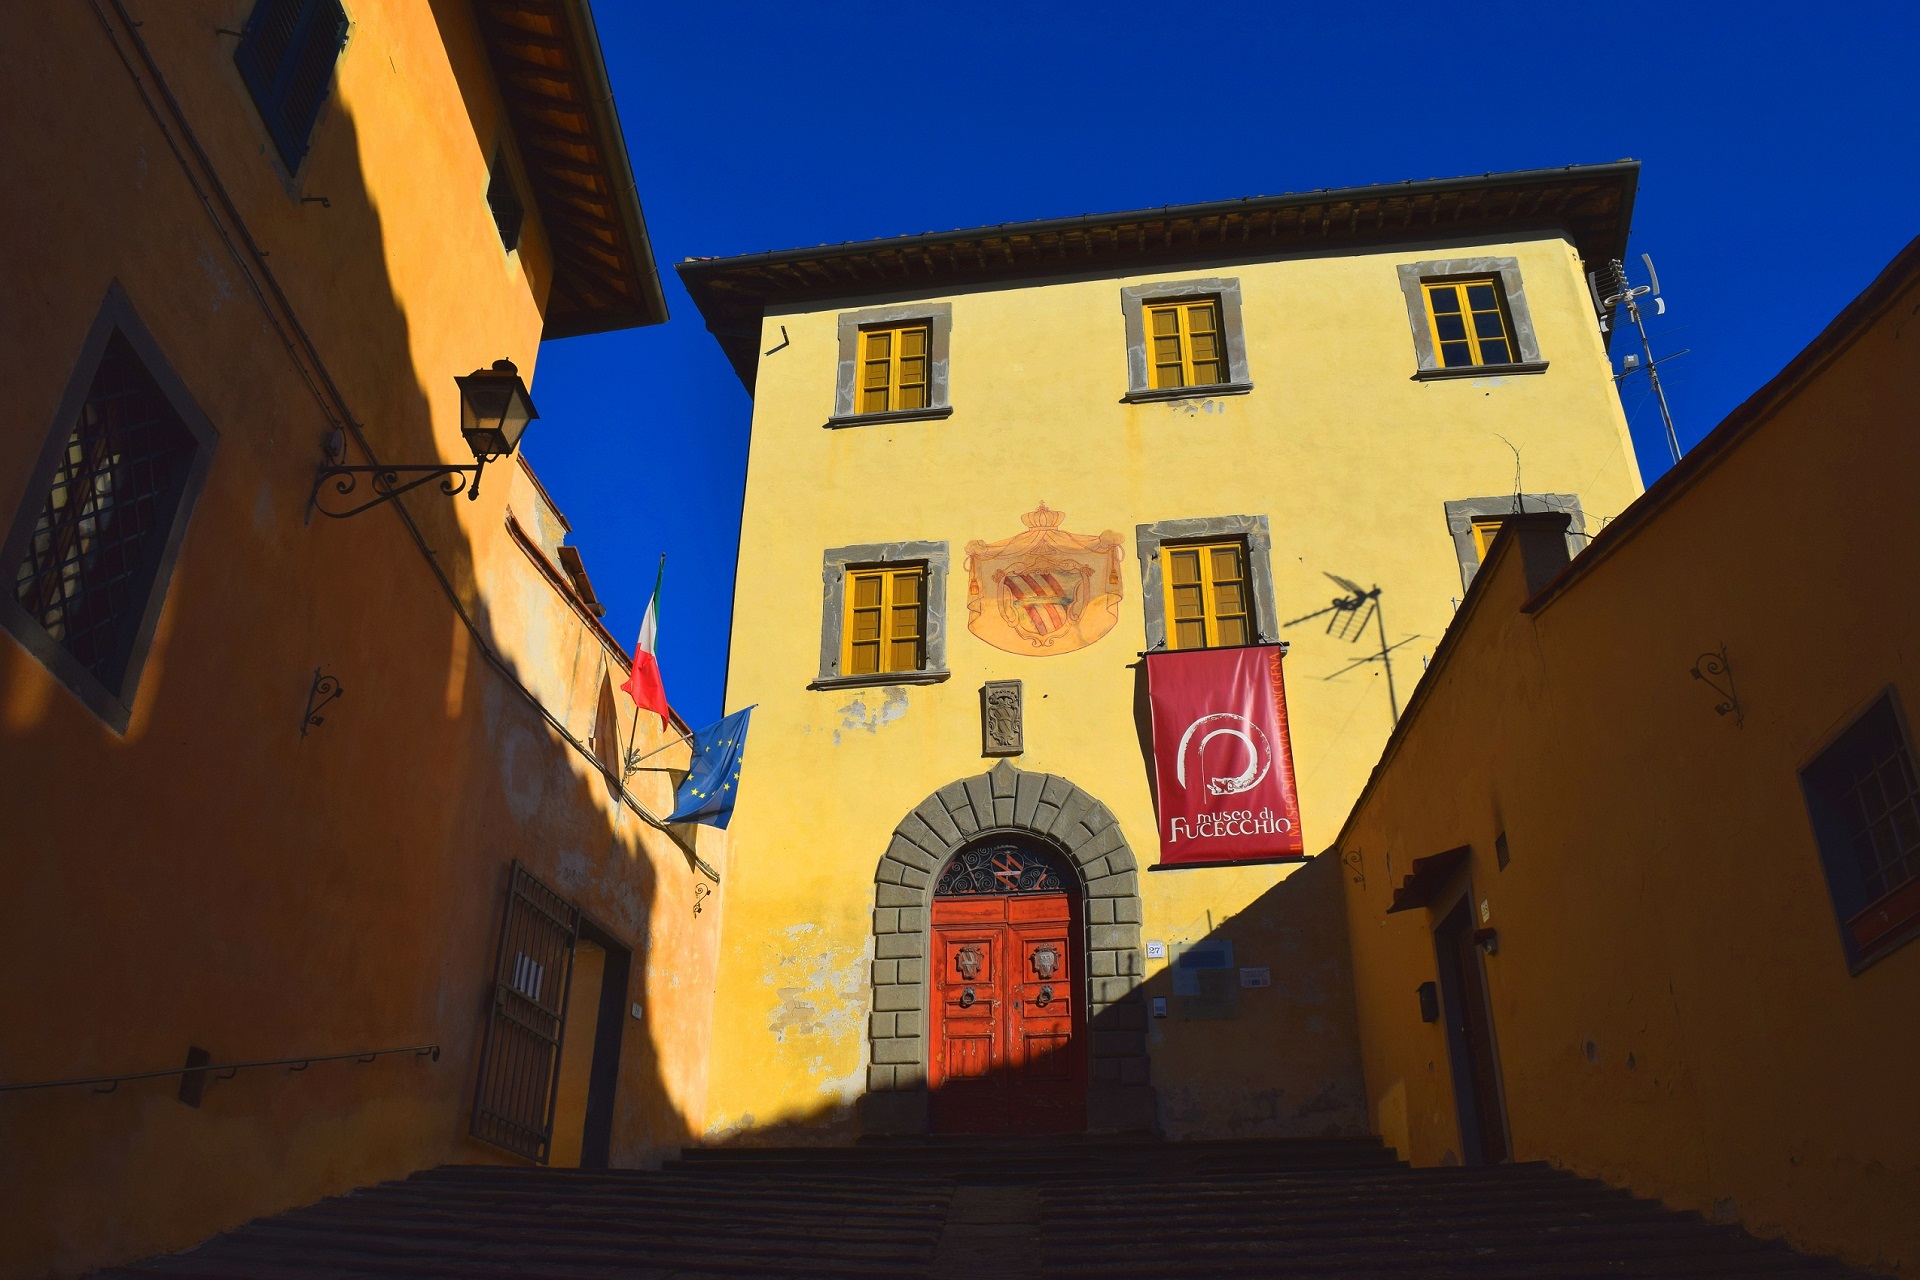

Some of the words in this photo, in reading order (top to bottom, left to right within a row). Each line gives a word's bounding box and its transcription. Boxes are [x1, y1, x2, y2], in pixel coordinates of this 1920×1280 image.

[1269, 652, 1287, 726] FRANCIGENA
[1279, 729, 1290, 750] VIA
[1280, 753, 1296, 790] SULLA
[1196, 810, 1252, 825] museo
[1259, 807, 1274, 820] di
[1285, 794, 1301, 837] MUSEO
[1168, 817, 1292, 843] FUCECCHIO
[1290, 841, 1302, 851] IL
[1148, 946, 1160, 954] 27
